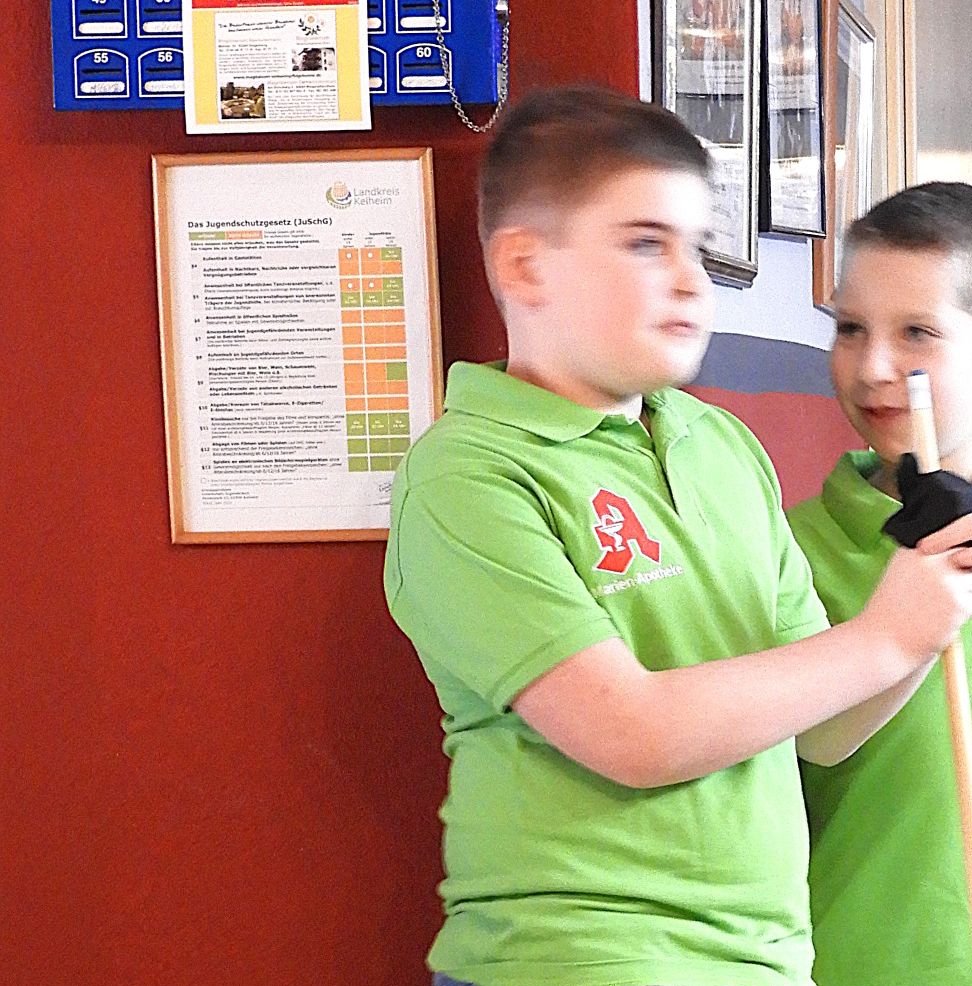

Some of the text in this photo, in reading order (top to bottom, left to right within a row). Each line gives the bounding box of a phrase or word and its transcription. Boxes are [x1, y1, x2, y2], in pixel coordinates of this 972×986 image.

[93, 52, 109, 64] 55
[157, 51, 173, 63] 56
[416, 46, 432, 58] 60
[353, 186, 400, 197] Landkreis
[354, 196, 393, 206] Kelheim
[188, 217, 333, 229] Das Jugendschutzgesetz (JuSchG)
